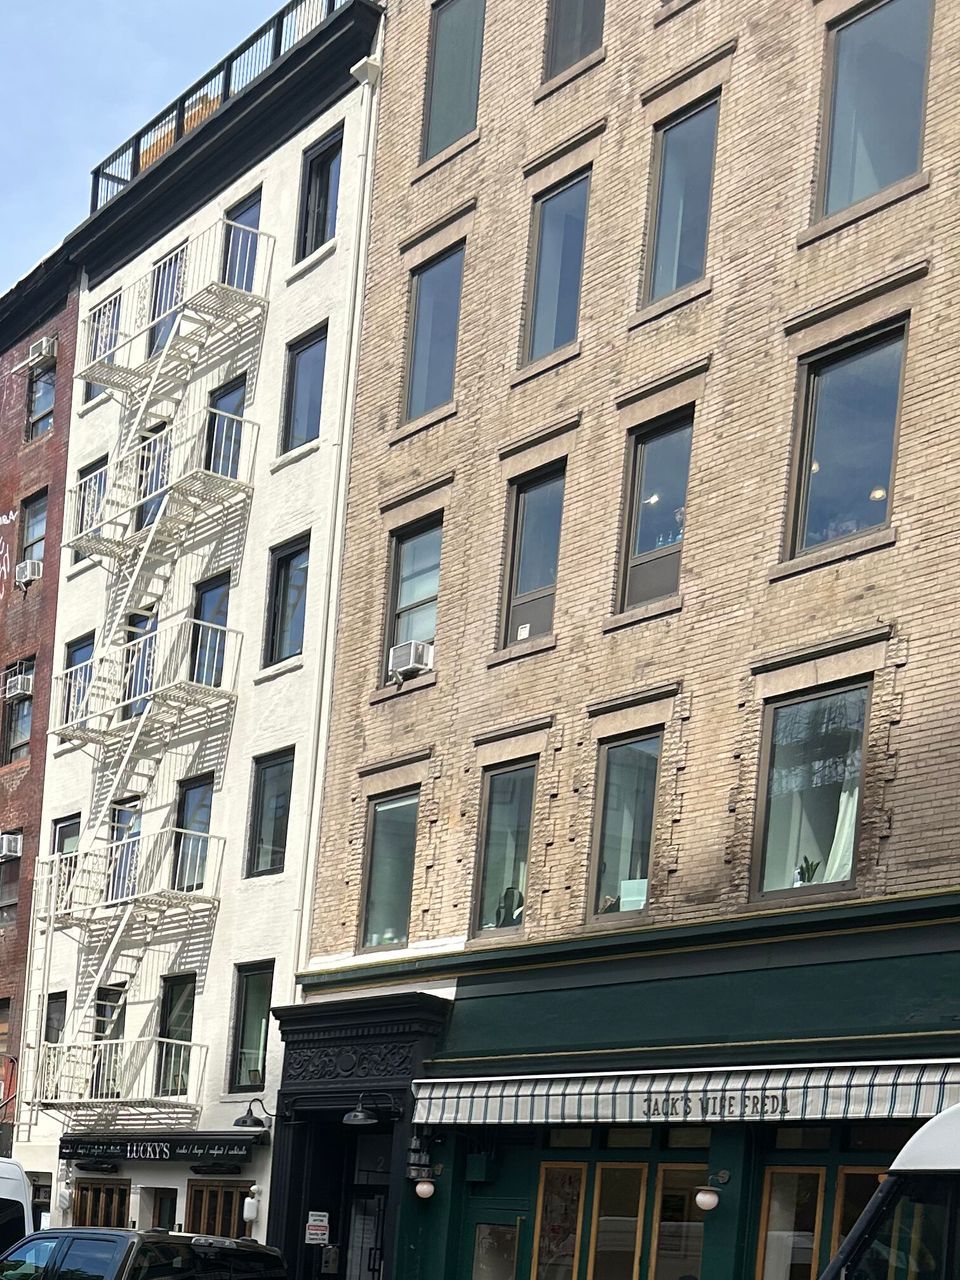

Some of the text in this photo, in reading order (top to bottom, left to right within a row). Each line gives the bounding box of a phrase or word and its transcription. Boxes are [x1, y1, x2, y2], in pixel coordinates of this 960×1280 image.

[643, 1093, 790, 1116] JACK'S WIFE FREDA
[127, 1142, 170, 1159] LUCKY'S
